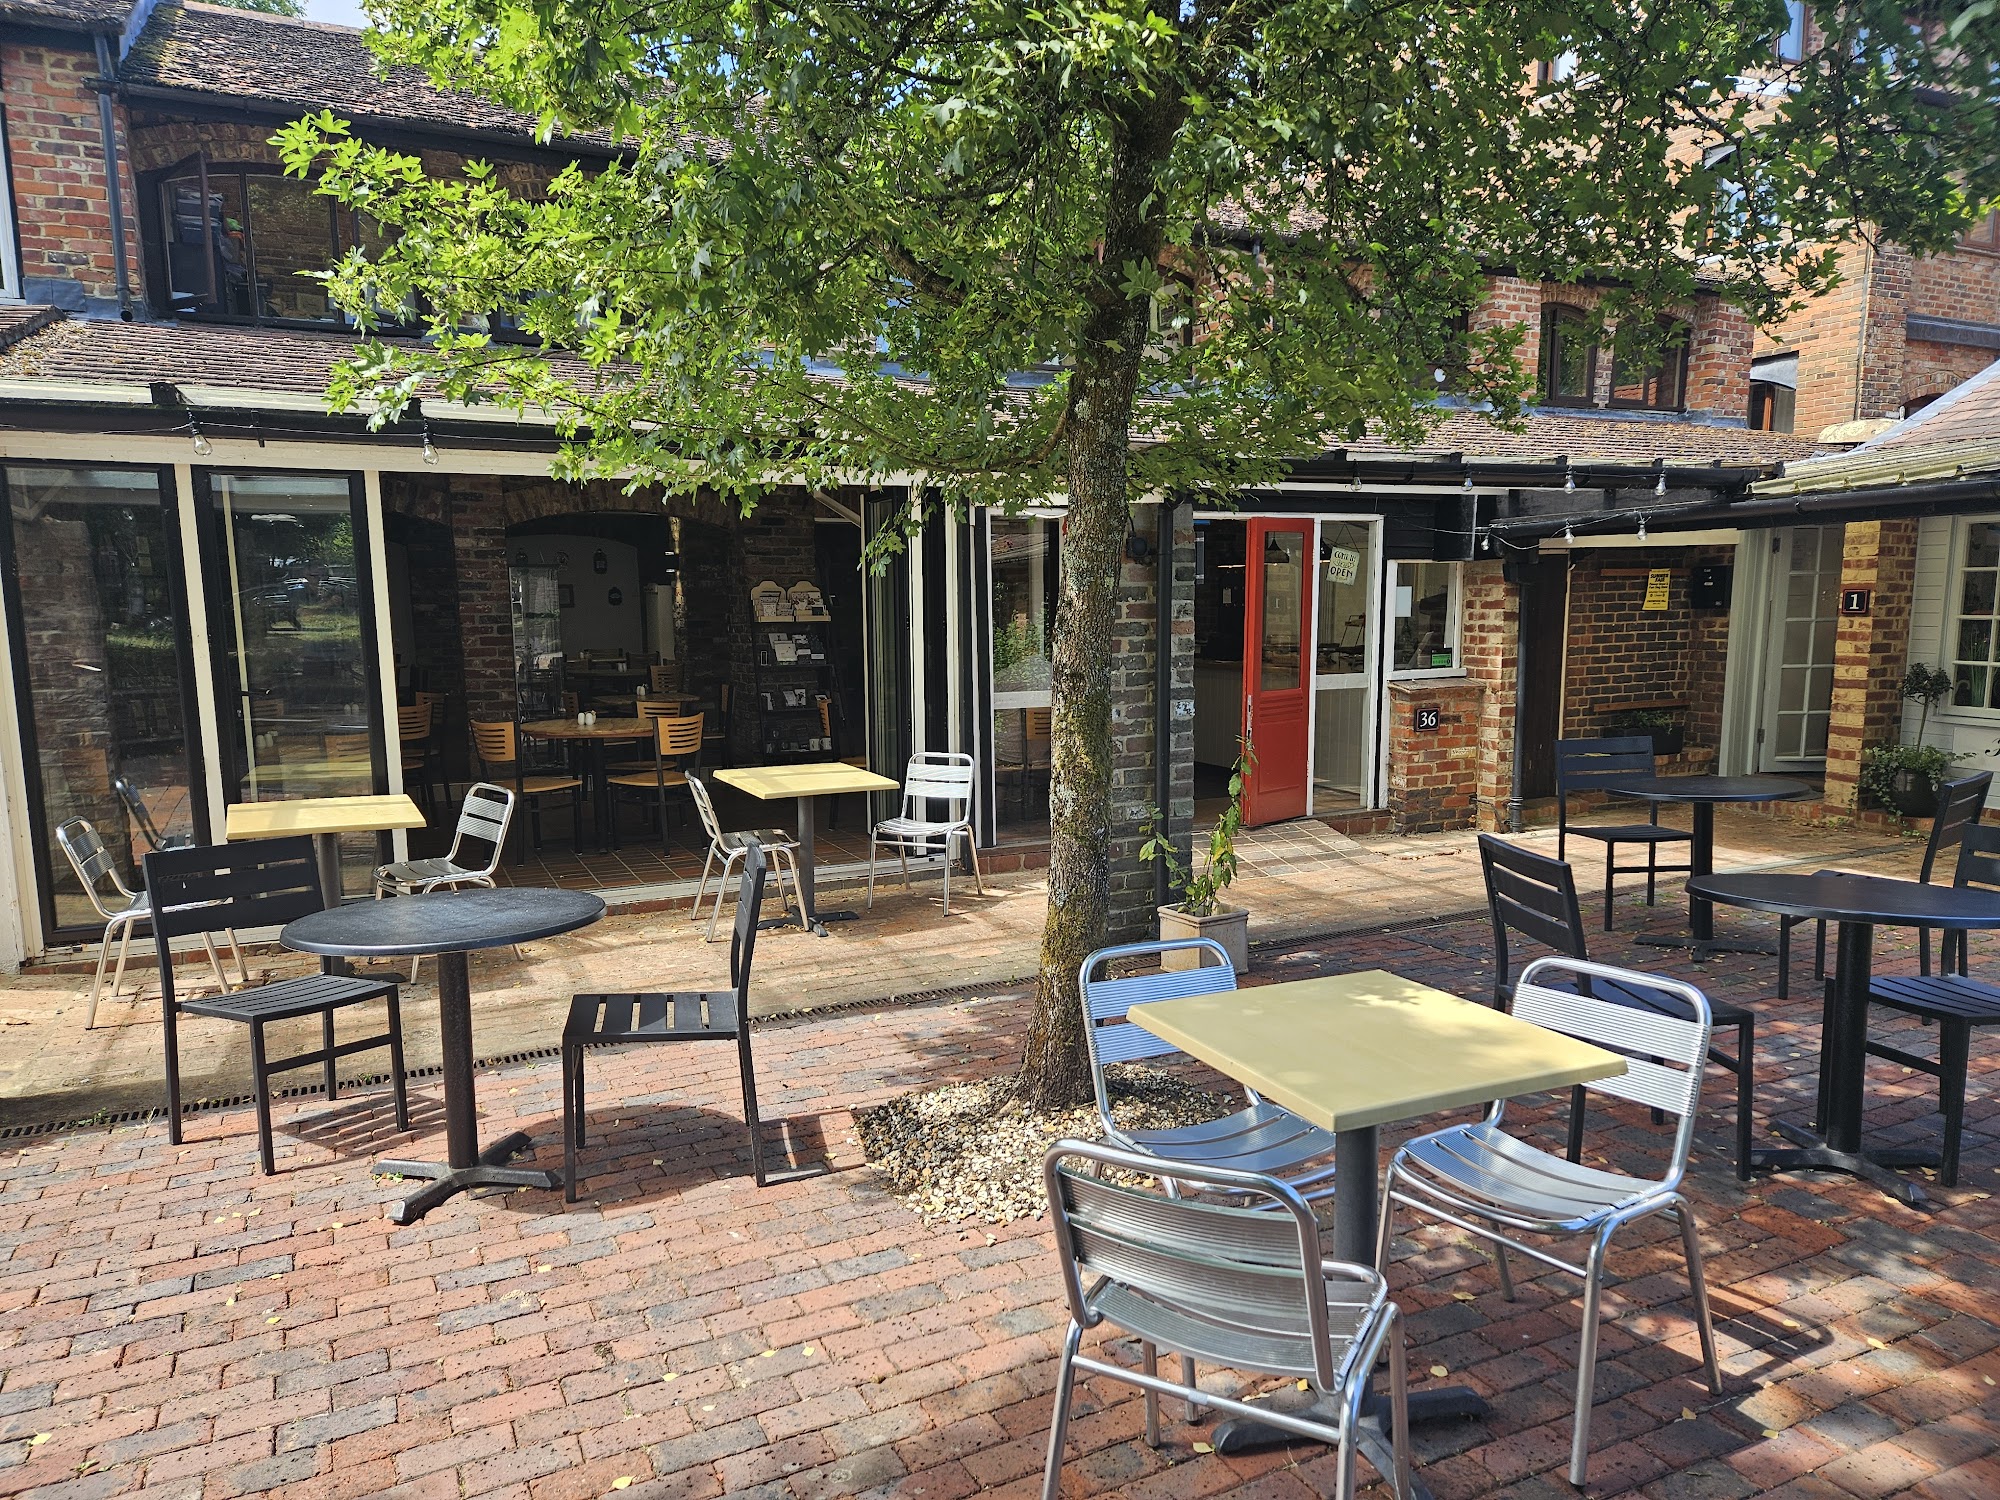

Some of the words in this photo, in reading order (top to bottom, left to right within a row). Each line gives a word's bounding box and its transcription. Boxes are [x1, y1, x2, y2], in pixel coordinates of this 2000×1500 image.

[1330, 566, 1352, 577] OPEN
[1849, 593, 1860, 610] 1
[1419, 711, 1437, 728] 36
